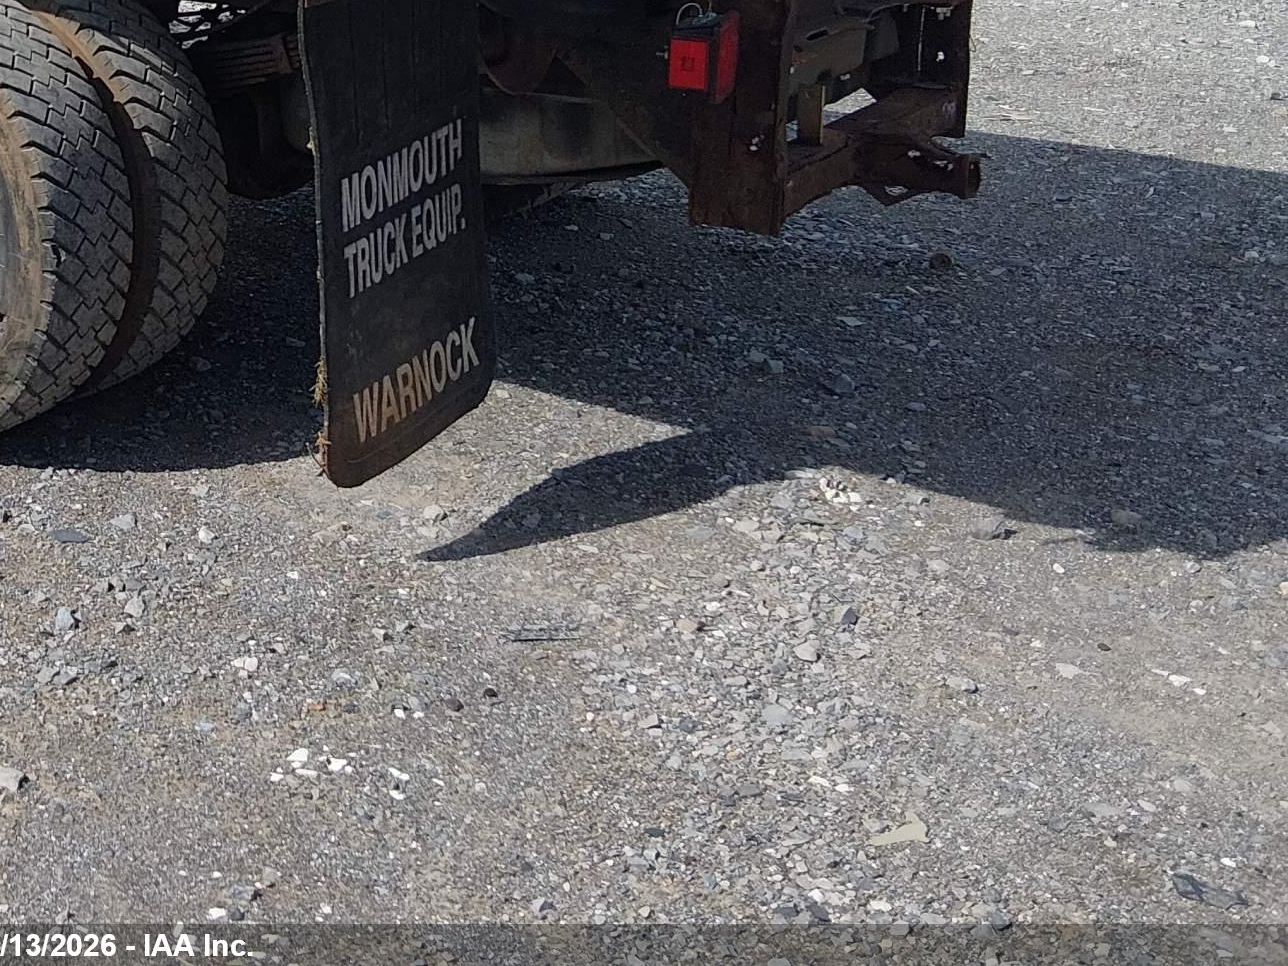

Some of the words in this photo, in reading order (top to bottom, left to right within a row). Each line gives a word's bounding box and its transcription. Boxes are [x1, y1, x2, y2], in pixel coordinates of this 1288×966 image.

[341, 118, 463, 233] MONMOUTH
[343, 213, 410, 300] TRUCK
[411, 183, 467, 260] EQUIP.
[352, 316, 481, 444] WARNOCK
